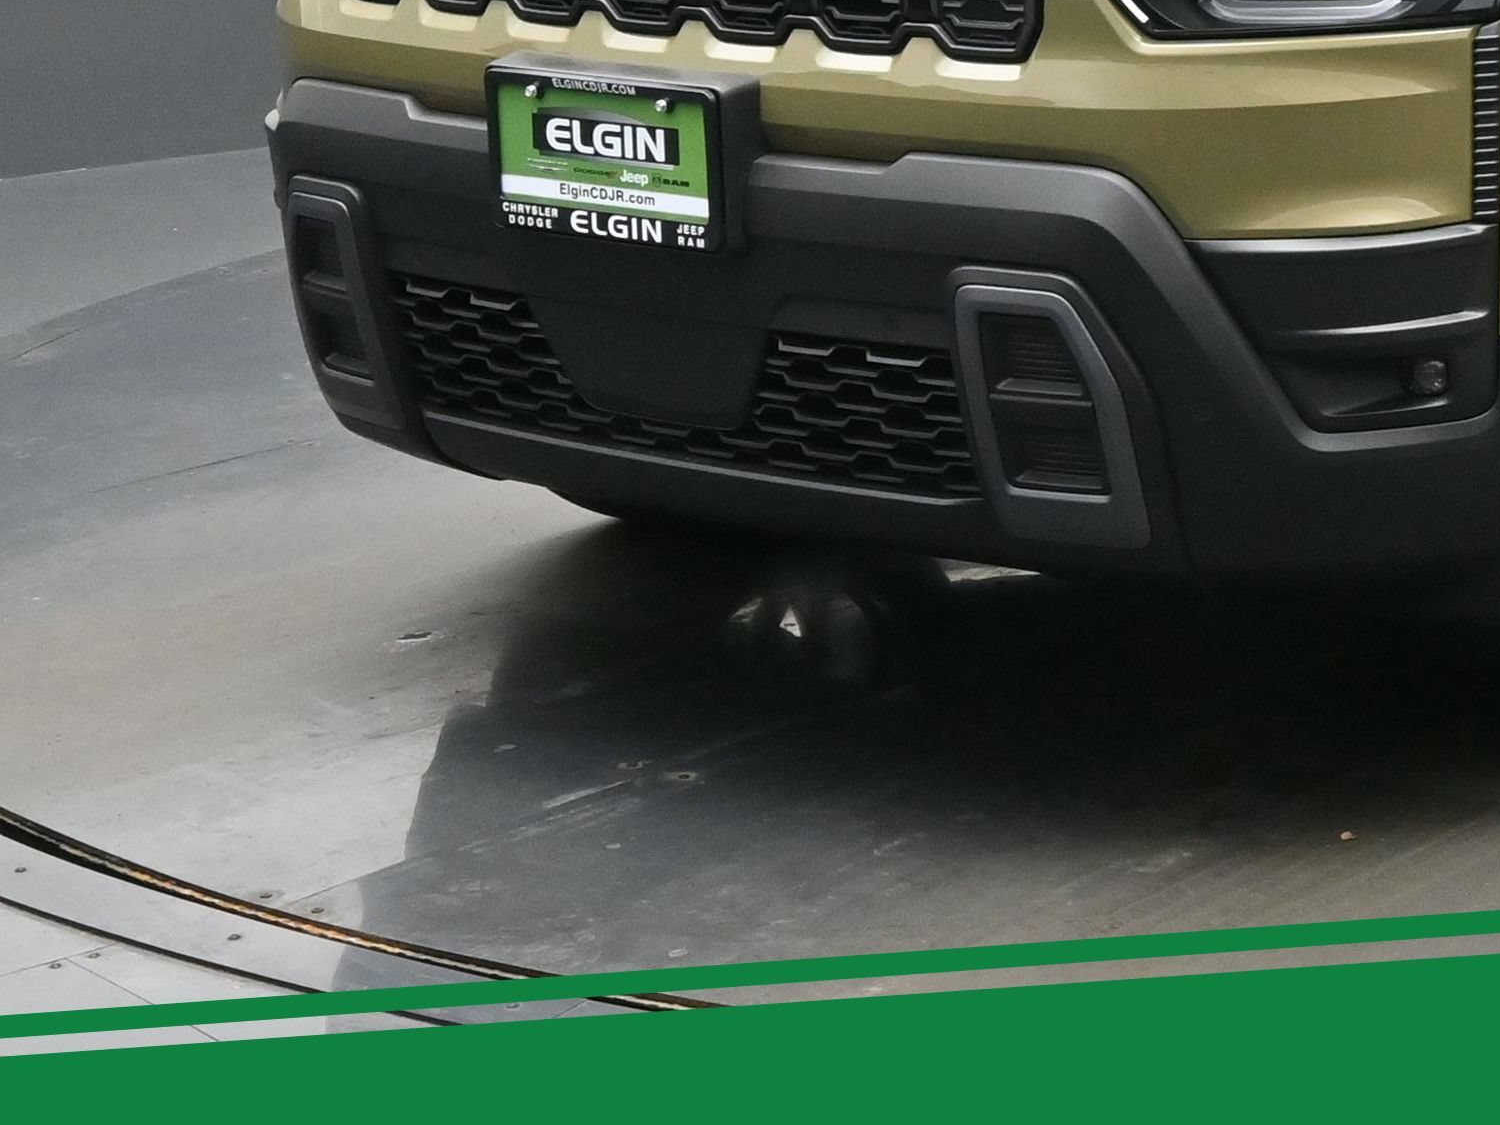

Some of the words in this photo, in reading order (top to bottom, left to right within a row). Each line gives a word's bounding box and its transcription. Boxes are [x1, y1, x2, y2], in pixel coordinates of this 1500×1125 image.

[551, 77, 637, 96] ELGINCDJR.COM
[545, 117, 666, 163] ELGIN
[619, 169, 649, 187] Jeep
[559, 183, 655, 206] ElginCDJR.com
[502, 201, 558, 218] CHRYSLER
[508, 214, 552, 229] DODGE
[570, 210, 662, 244] ELGIN
[676, 223, 705, 236] JEEP
[677, 235, 705, 249] RAM
